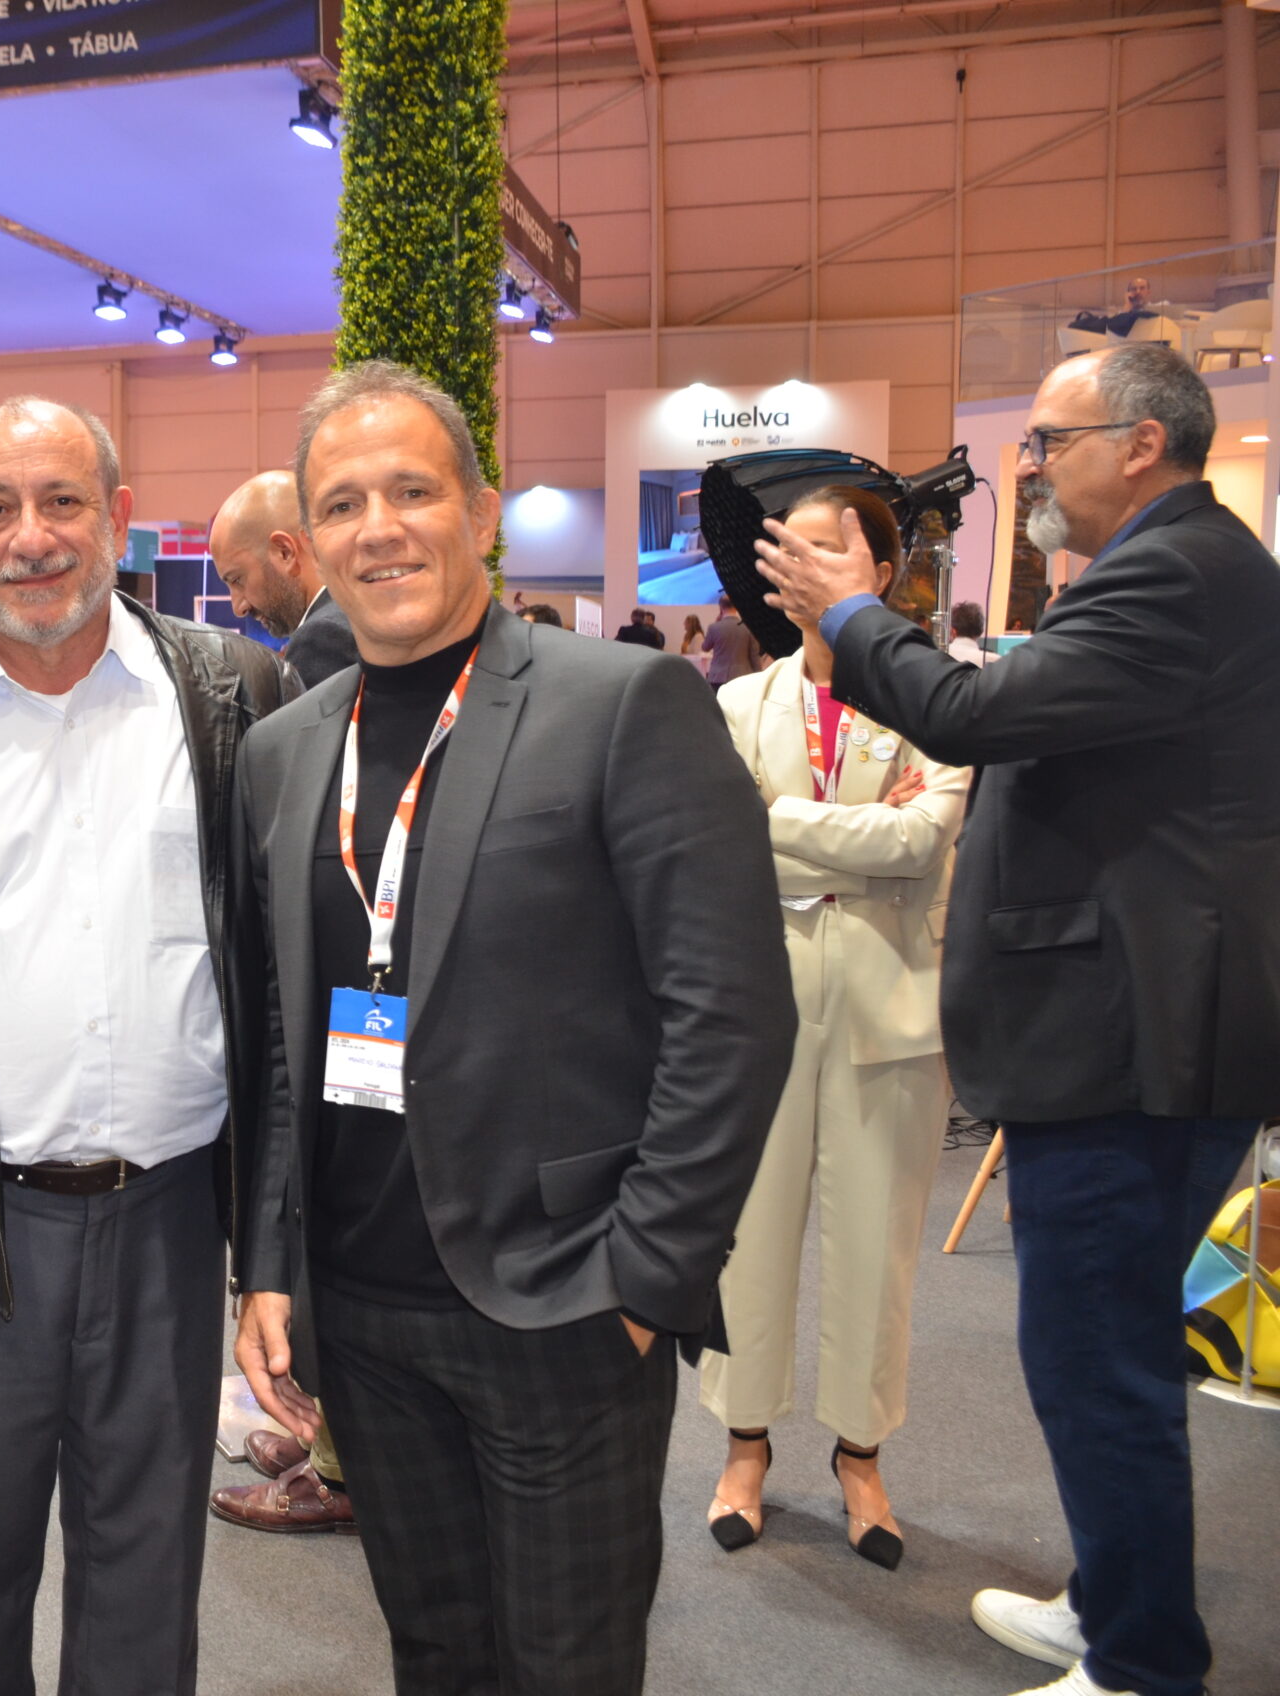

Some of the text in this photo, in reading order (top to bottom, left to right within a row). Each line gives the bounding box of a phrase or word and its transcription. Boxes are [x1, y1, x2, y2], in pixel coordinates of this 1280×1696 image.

[69, 30, 139, 58] TÁBUA
[703, 405, 790, 428] Huelva
[381, 880, 396, 902] BPI
[365, 1020, 383, 1031] FIL
